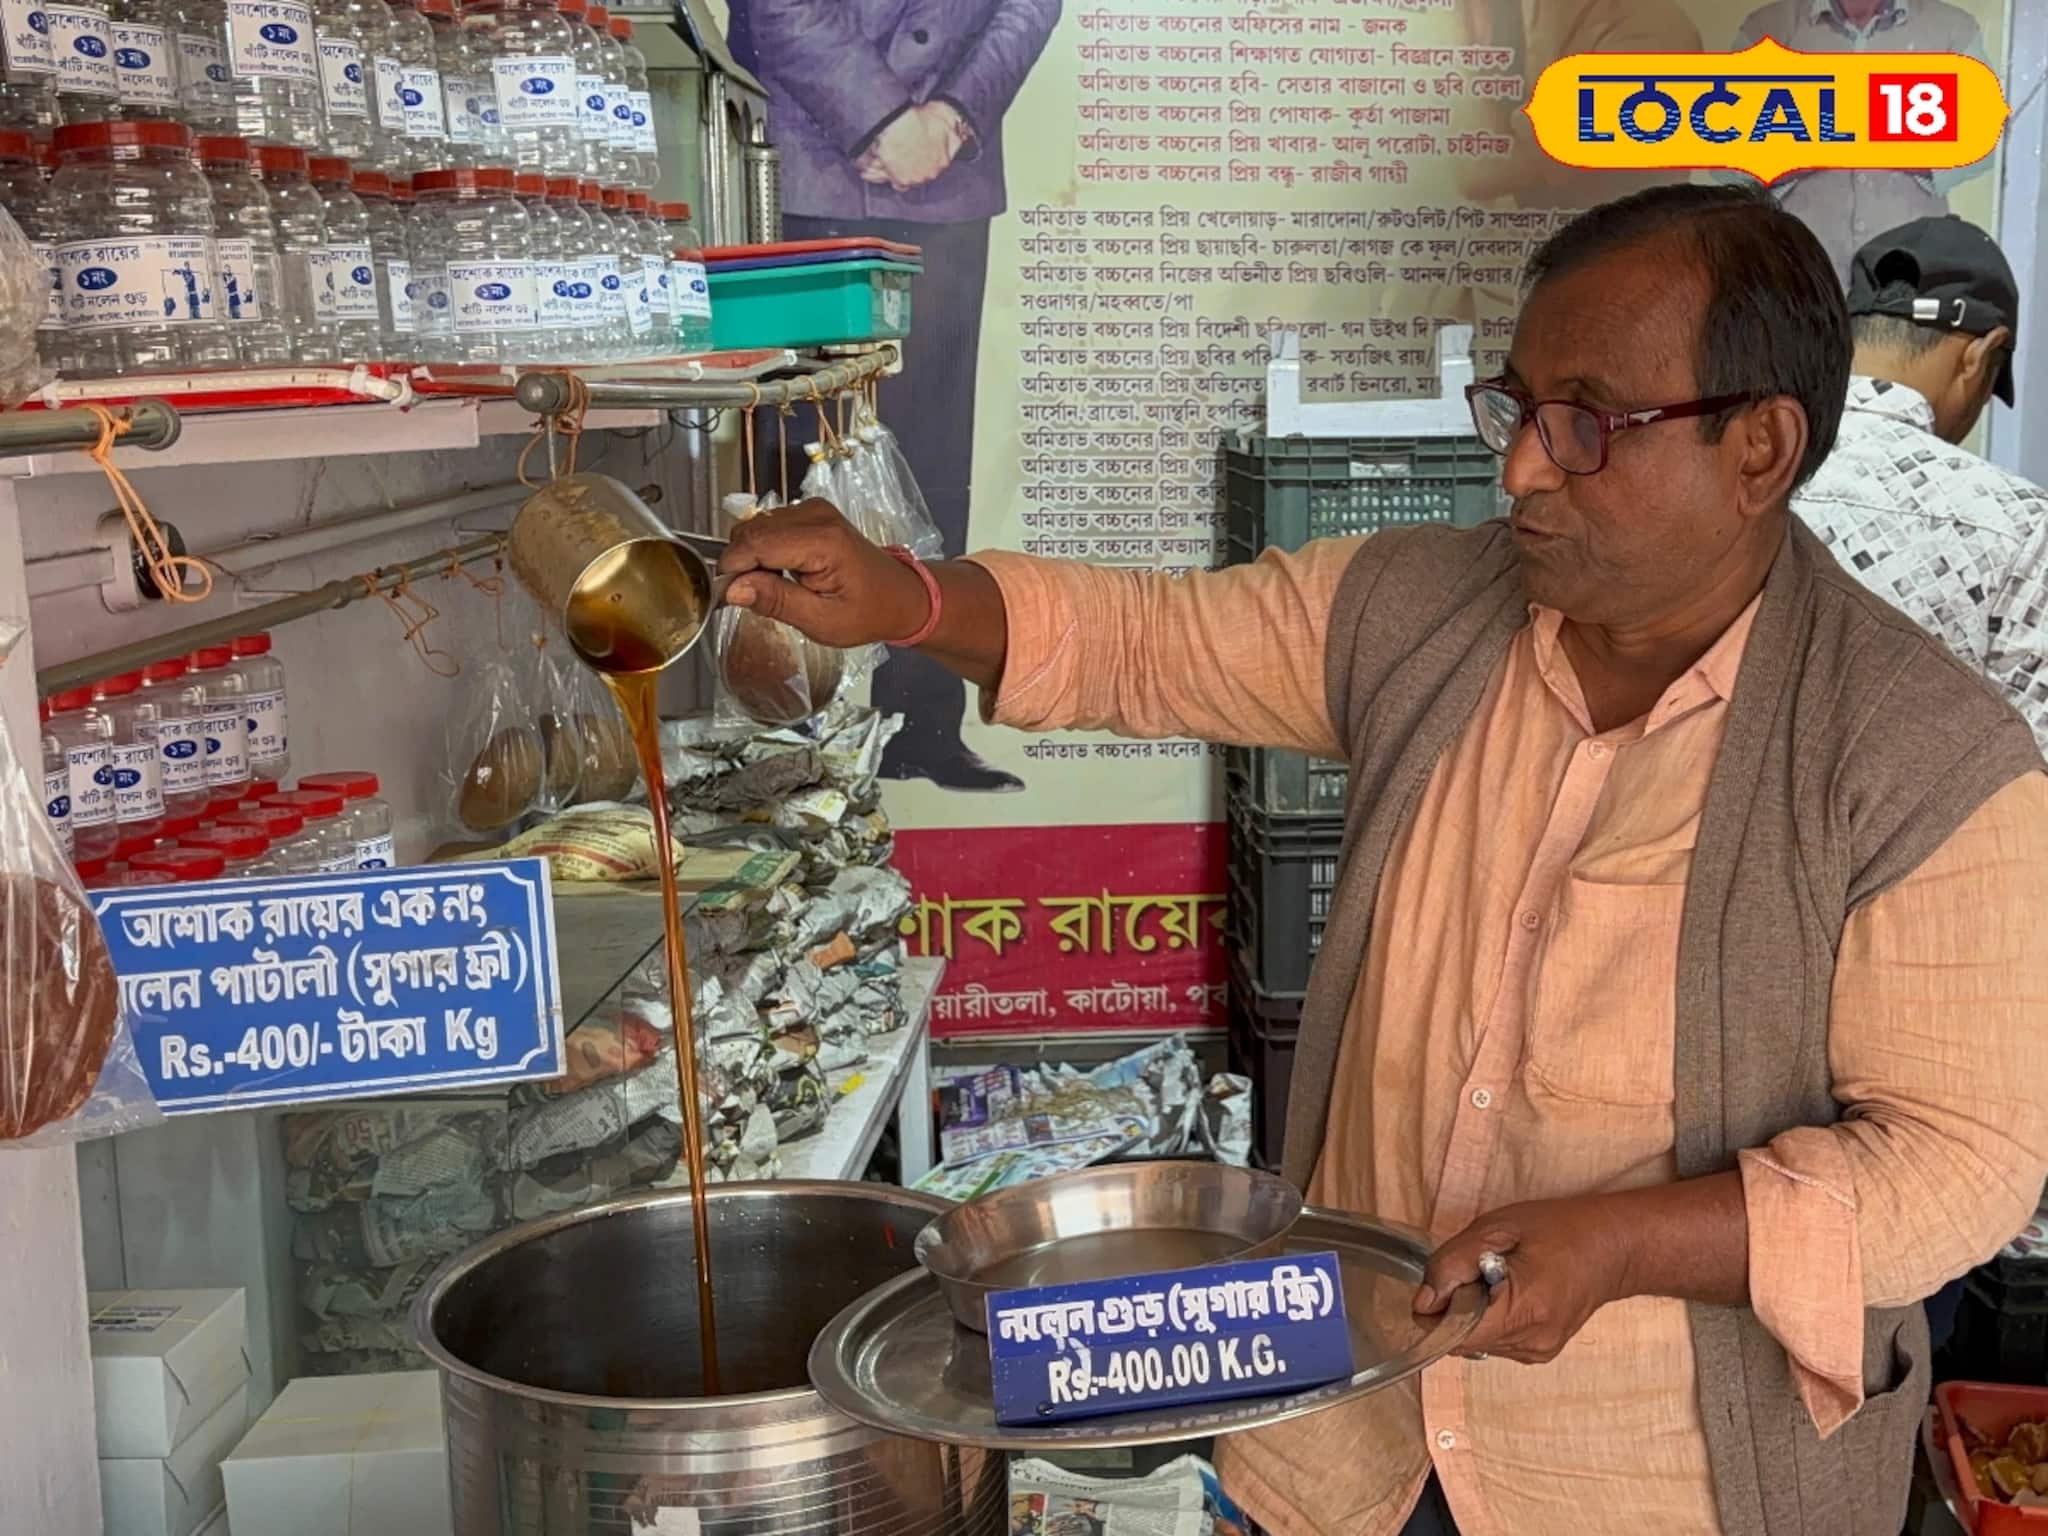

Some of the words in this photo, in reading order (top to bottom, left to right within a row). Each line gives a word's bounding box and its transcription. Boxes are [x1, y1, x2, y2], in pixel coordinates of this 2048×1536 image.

[1078, 8, 1151, 32] অমিতাভ
[1157, 15, 1222, 32] বচ্চনের
[1229, 10, 1302, 34] অফিসের
[1309, 17, 1340, 34] নাম
[1362, 18, 1407, 35] জনক
[1078, 38, 1151, 63] অমিতাভ
[1157, 46, 1222, 63] বচ্চনের
[1230, 40, 1302, 64] শিক্ষাগত
[1078, 68, 1151, 92] অমিতাভ
[1157, 75, 1222, 93] বচ্চনের
[1277, 78, 1331, 95] সেতার
[1338, 78, 1405, 95] বাজানো
[1413, 81, 1425, 95] ও
[1432, 72, 1463, 97] ছবি
[1472, 79, 1520, 96] তোলা
[1078, 98, 1151, 122] অমিতাভ
[1157, 105, 1222, 123] বচ্চনের
[1229, 100, 1260, 123] প্রিয়
[1390, 107, 1450, 126] পাজামা
[1078, 128, 1151, 152] অমিতাভ
[1157, 135, 1222, 153] বচ্চনের
[1229, 129, 1260, 152] প্রিয়
[1332, 136, 1369, 159] আলু
[1447, 132, 1510, 156] চাইনিজ
[1078, 158, 1151, 181] অমিতাভ
[1157, 165, 1222, 182] বচ্চনের
[1229, 159, 1260, 182] প্রিয়
[1311, 160, 1361, 184] রাজীব
[1368, 160, 1409, 184] গান্ধী
[1020, 204, 1087, 226] অমিতাভ
[1092, 211, 1153, 227] বচ্চনের
[1160, 204, 1190, 227] প্রিয়
[1020, 233, 1087, 254] অমিতাভ
[1093, 240, 1153, 255] বচ্চনের
[1160, 233, 1190, 254] প্রিয়
[1401, 240, 1424, 256] কে
[1020, 261, 1087, 282] অমিতাভ
[1093, 267, 1153, 282] বচ্চনের
[1160, 261, 1212, 282] নিজের
[1218, 261, 1283, 283] অভিনীত
[1289, 261, 1318, 283] প্রিয়
[1020, 316, 1087, 338] অমিতাভ
[1093, 322, 1153, 338] বচ্চনের
[1160, 316, 1189, 338] প্রিয়
[1196, 315, 1249, 338] বিদেশী
[1021, 344, 1087, 366] অমিতাভ
[1094, 350, 1153, 366] বচ্চনের
[1160, 344, 1189, 367] প্রিয়
[1195, 343, 1236, 369] ছবির
[1021, 372, 1087, 393] অমিতাভ
[1094, 378, 1153, 393] বচ্চনের
[1160, 371, 1189, 394] প্রিয়
[1021, 426, 1087, 449] অমিতাভ
[1094, 433, 1153, 448] বচ্চনের
[1160, 426, 1189, 449] প্রিয়
[1022, 453, 1087, 475] অমিতাভ
[1094, 460, 1153, 475] বচ্চনের
[1160, 453, 1189, 475] প্রিয়
[1022, 480, 1087, 502] অমিতাভ
[1094, 487, 1153, 502] বচ্চনের
[1160, 480, 1189, 502] প্রিয়
[1022, 507, 1087, 529] অমিতাভ
[1094, 513, 1153, 528] বচ্চনের
[1160, 507, 1189, 529] প্রিয়
[1022, 534, 1087, 555] অমিতাভ
[1095, 540, 1153, 555] বচ্চনের
[1024, 739, 1089, 760] অমিতাভ
[1094, 744, 1152, 759] বচ্চনের
[121, 899, 254, 948] অশোক
[260, 891, 364, 944] রায়ের
[371, 883, 434, 927] এক
[439, 881, 487, 927] নং
[210, 944, 339, 1007] পাটালী
[160, 1021, 333, 1080] Rs.-400/-
[337, 1006, 427, 1064] টাকা
[445, 1006, 499, 1060] Kg
[1219, 1334, 1286, 1382] K.G.
